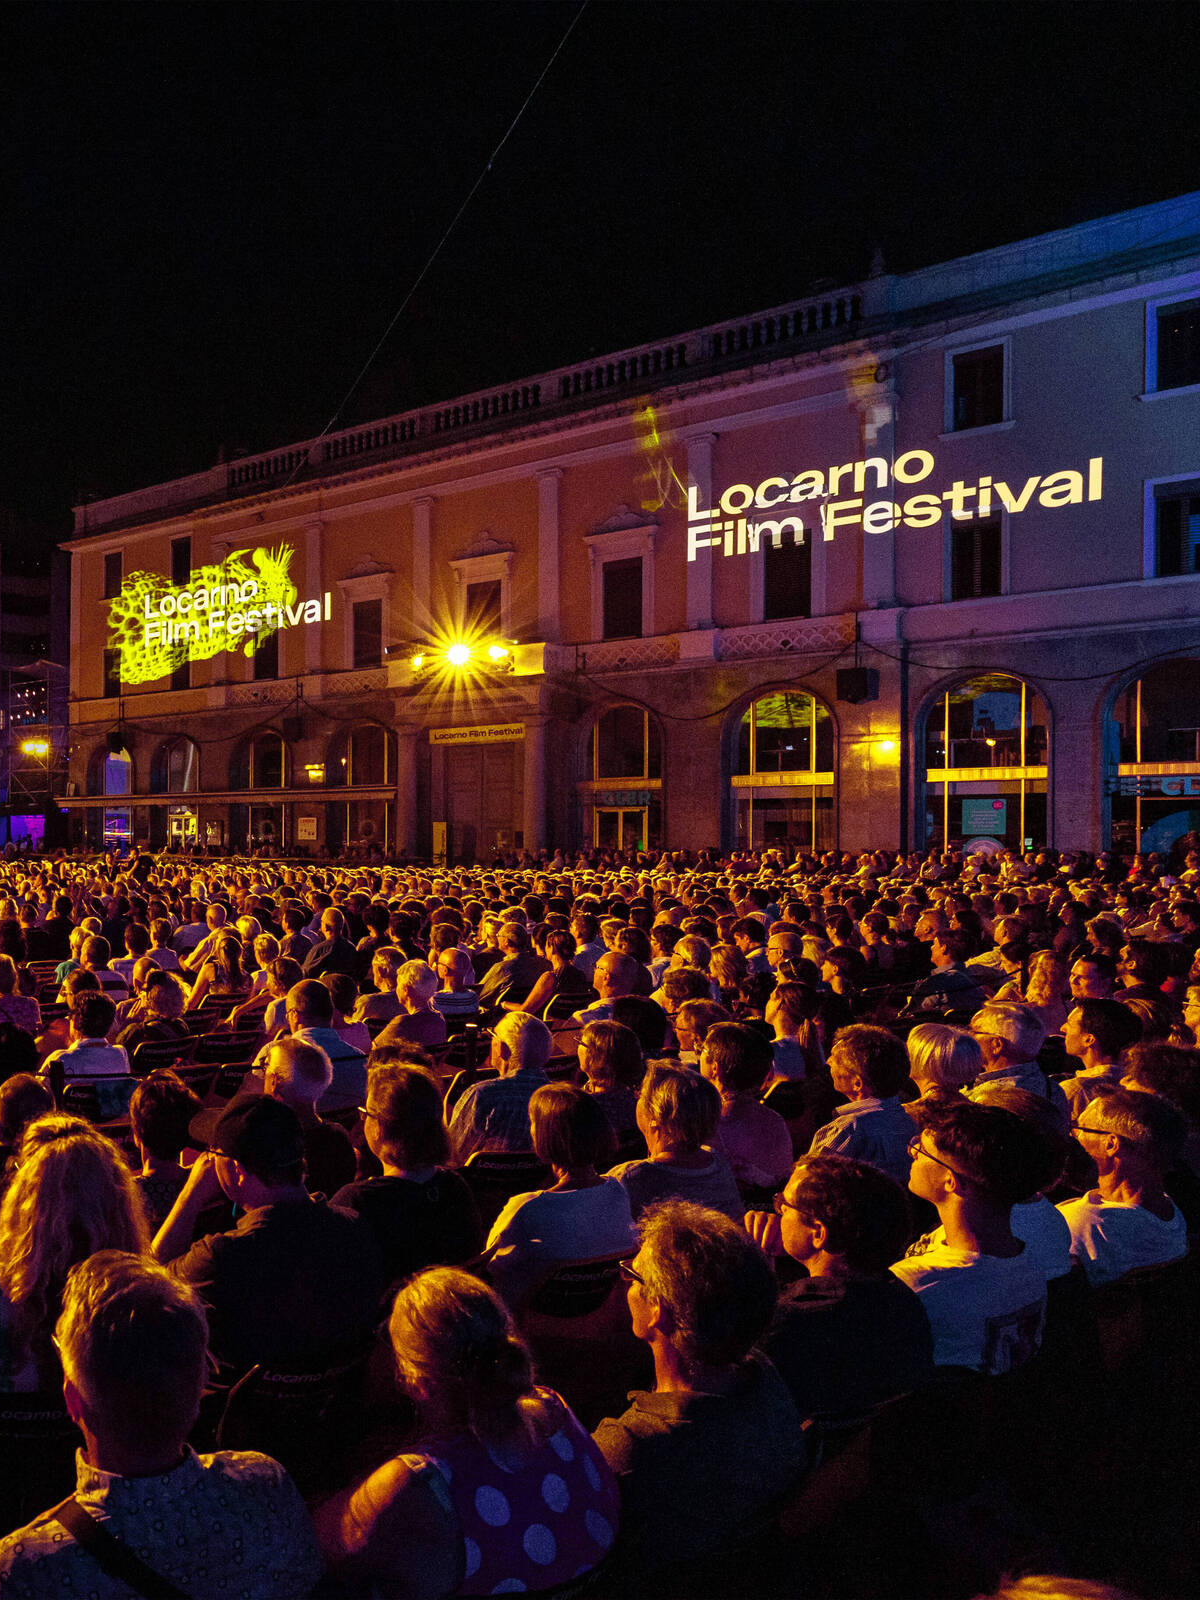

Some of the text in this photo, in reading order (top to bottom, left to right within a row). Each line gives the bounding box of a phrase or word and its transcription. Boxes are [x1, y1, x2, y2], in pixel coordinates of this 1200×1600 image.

[687, 449, 936, 521] Locarno
[687, 456, 1104, 562] Film Festival
[144, 579, 258, 620] Locarno
[144, 591, 332, 648] Film Festival
[434, 727, 523, 740] Locarno Film Festival
[1160, 775, 1200, 796] CL
